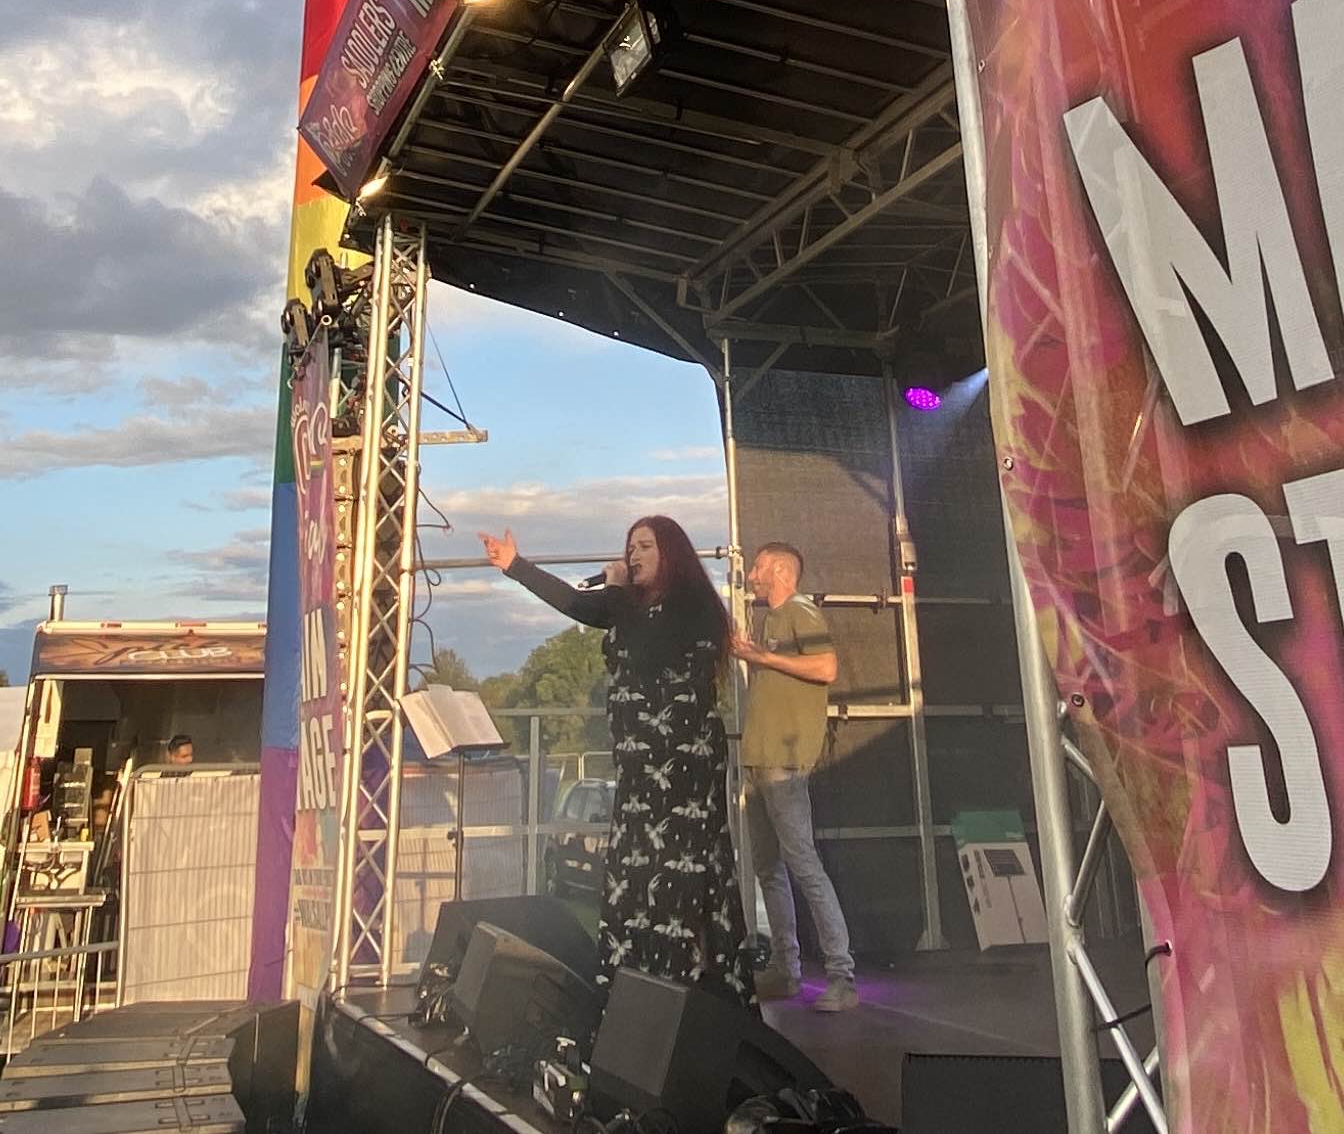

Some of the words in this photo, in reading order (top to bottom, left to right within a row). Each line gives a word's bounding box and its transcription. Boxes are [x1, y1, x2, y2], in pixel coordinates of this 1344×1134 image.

[389, 30, 417, 79] CENTRE
[128, 646, 233, 665] CLUB
[297, 714, 336, 811] AGE
